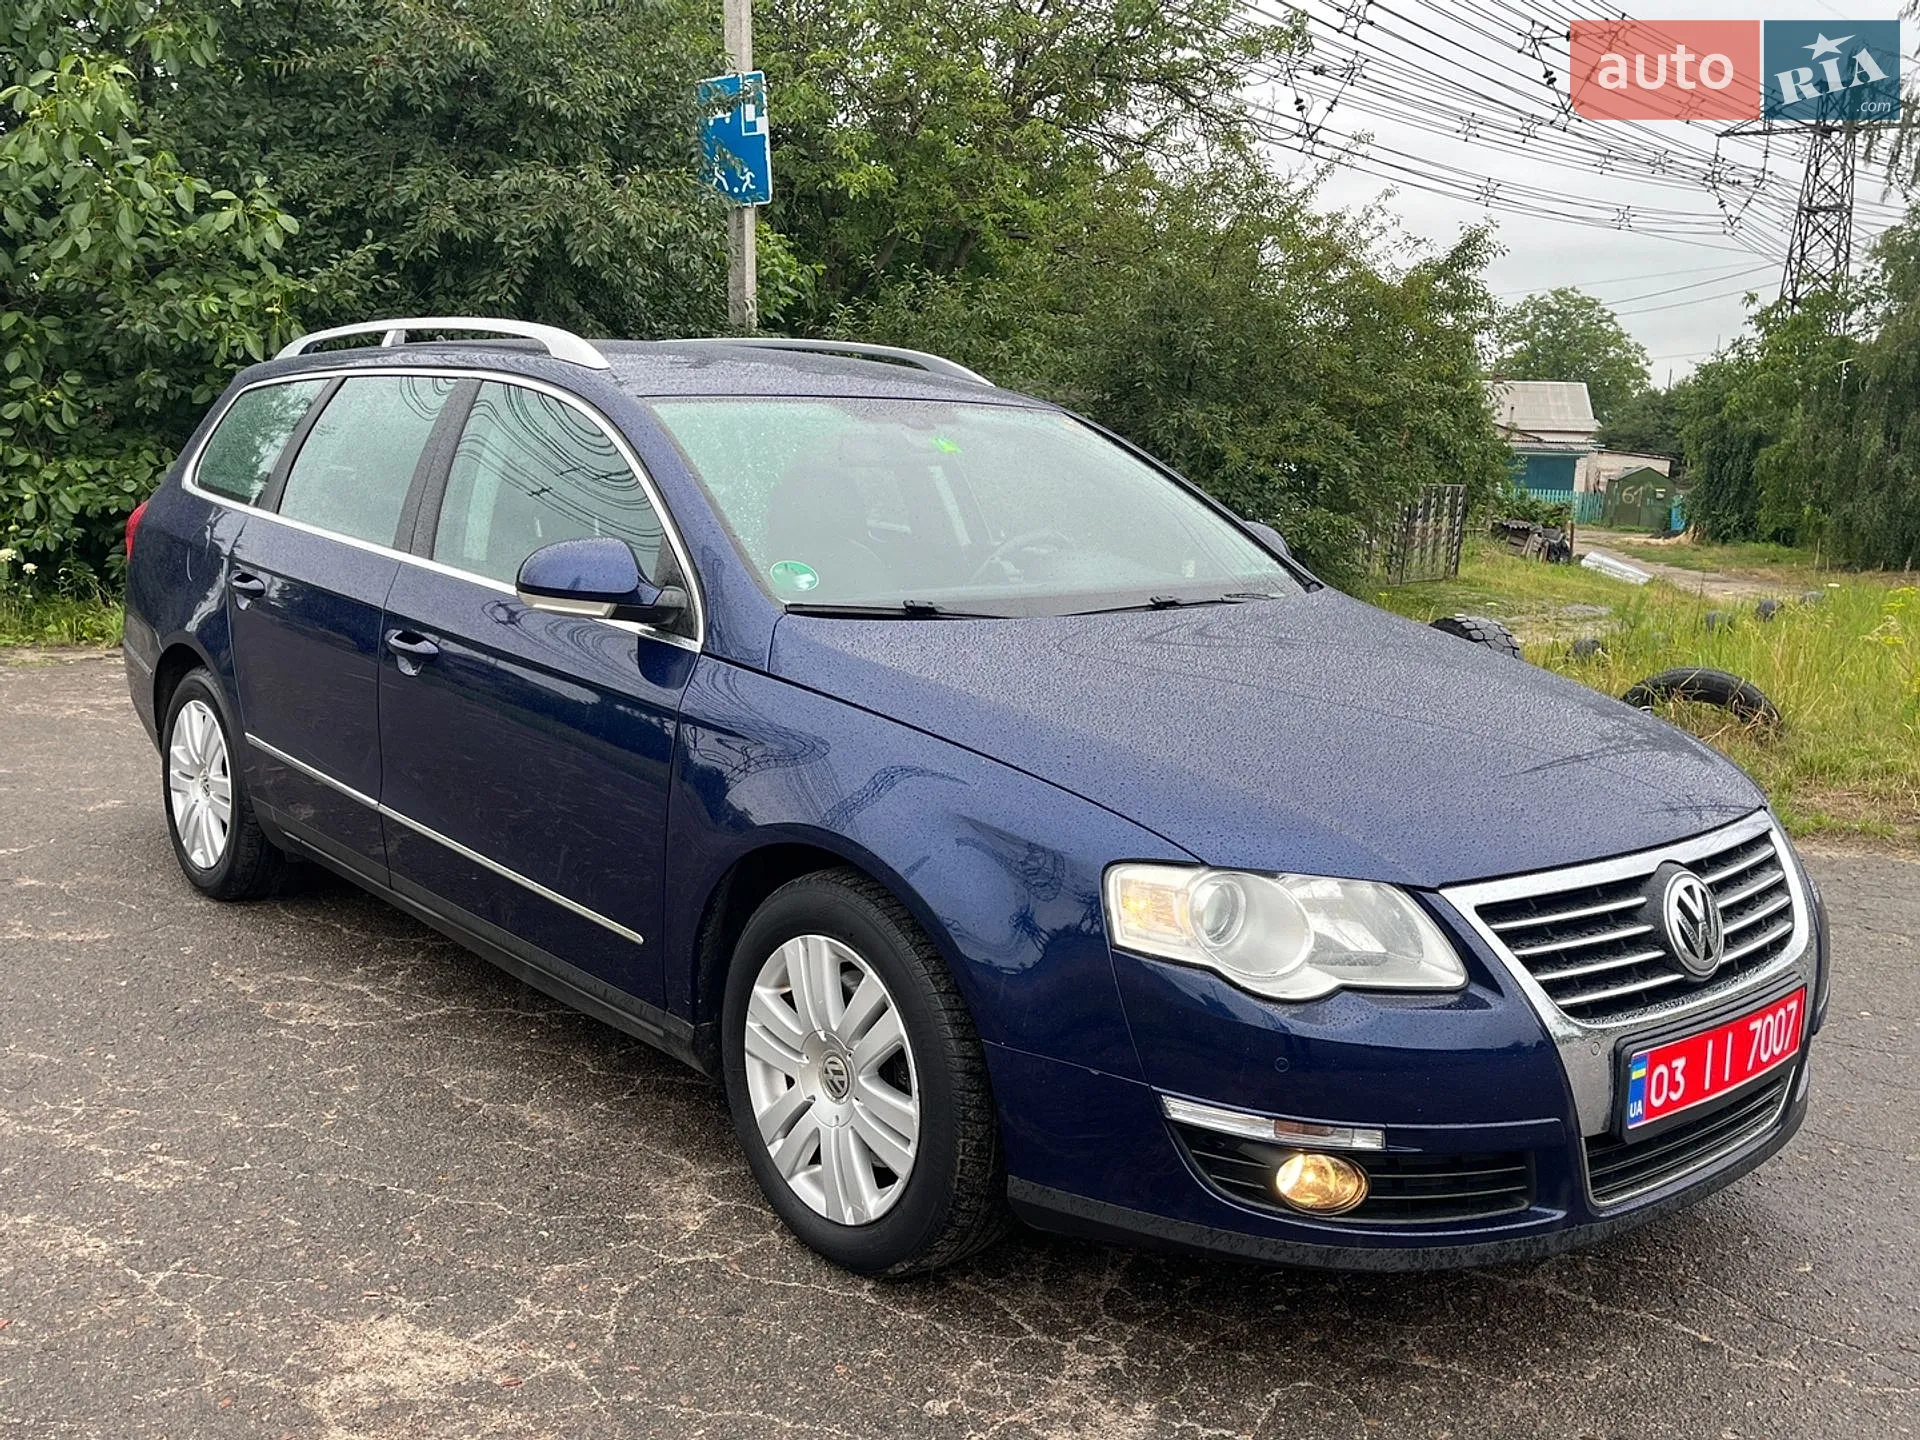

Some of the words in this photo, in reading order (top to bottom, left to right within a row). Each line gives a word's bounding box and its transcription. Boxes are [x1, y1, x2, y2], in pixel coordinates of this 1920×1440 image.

[1649, 1056, 1687, 1108] 03
[1746, 999, 1799, 1072] 7007
[1629, 1099, 1643, 1119] UA
